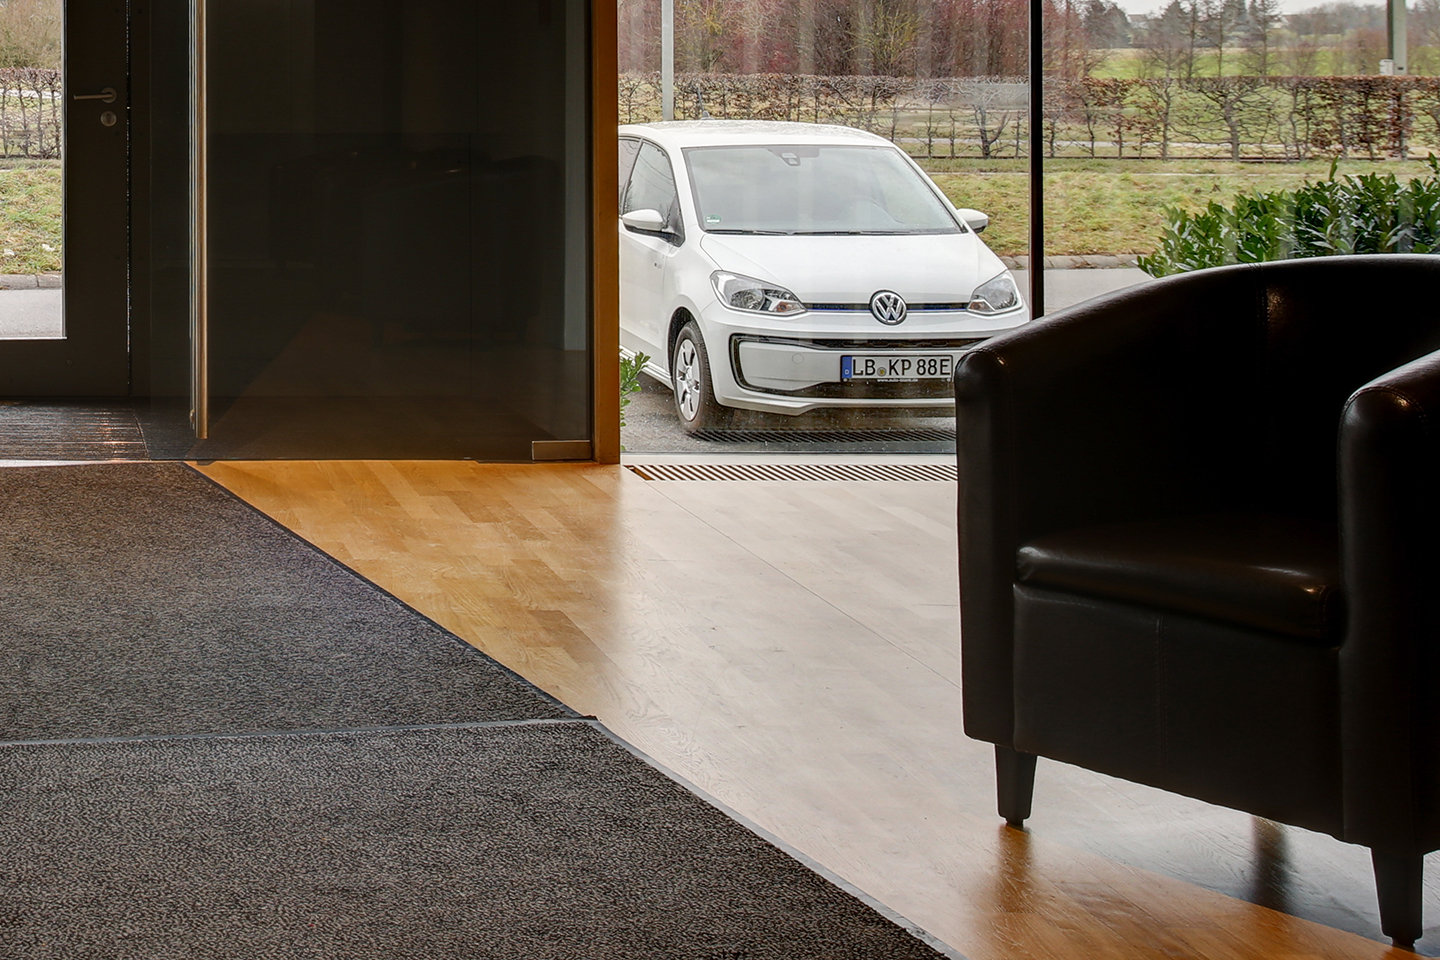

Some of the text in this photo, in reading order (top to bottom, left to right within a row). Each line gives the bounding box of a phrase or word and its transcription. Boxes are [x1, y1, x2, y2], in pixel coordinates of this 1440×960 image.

[852, 359, 876, 376] LB
[888, 359, 912, 376] KP
[916, 359, 951, 376] 88E
